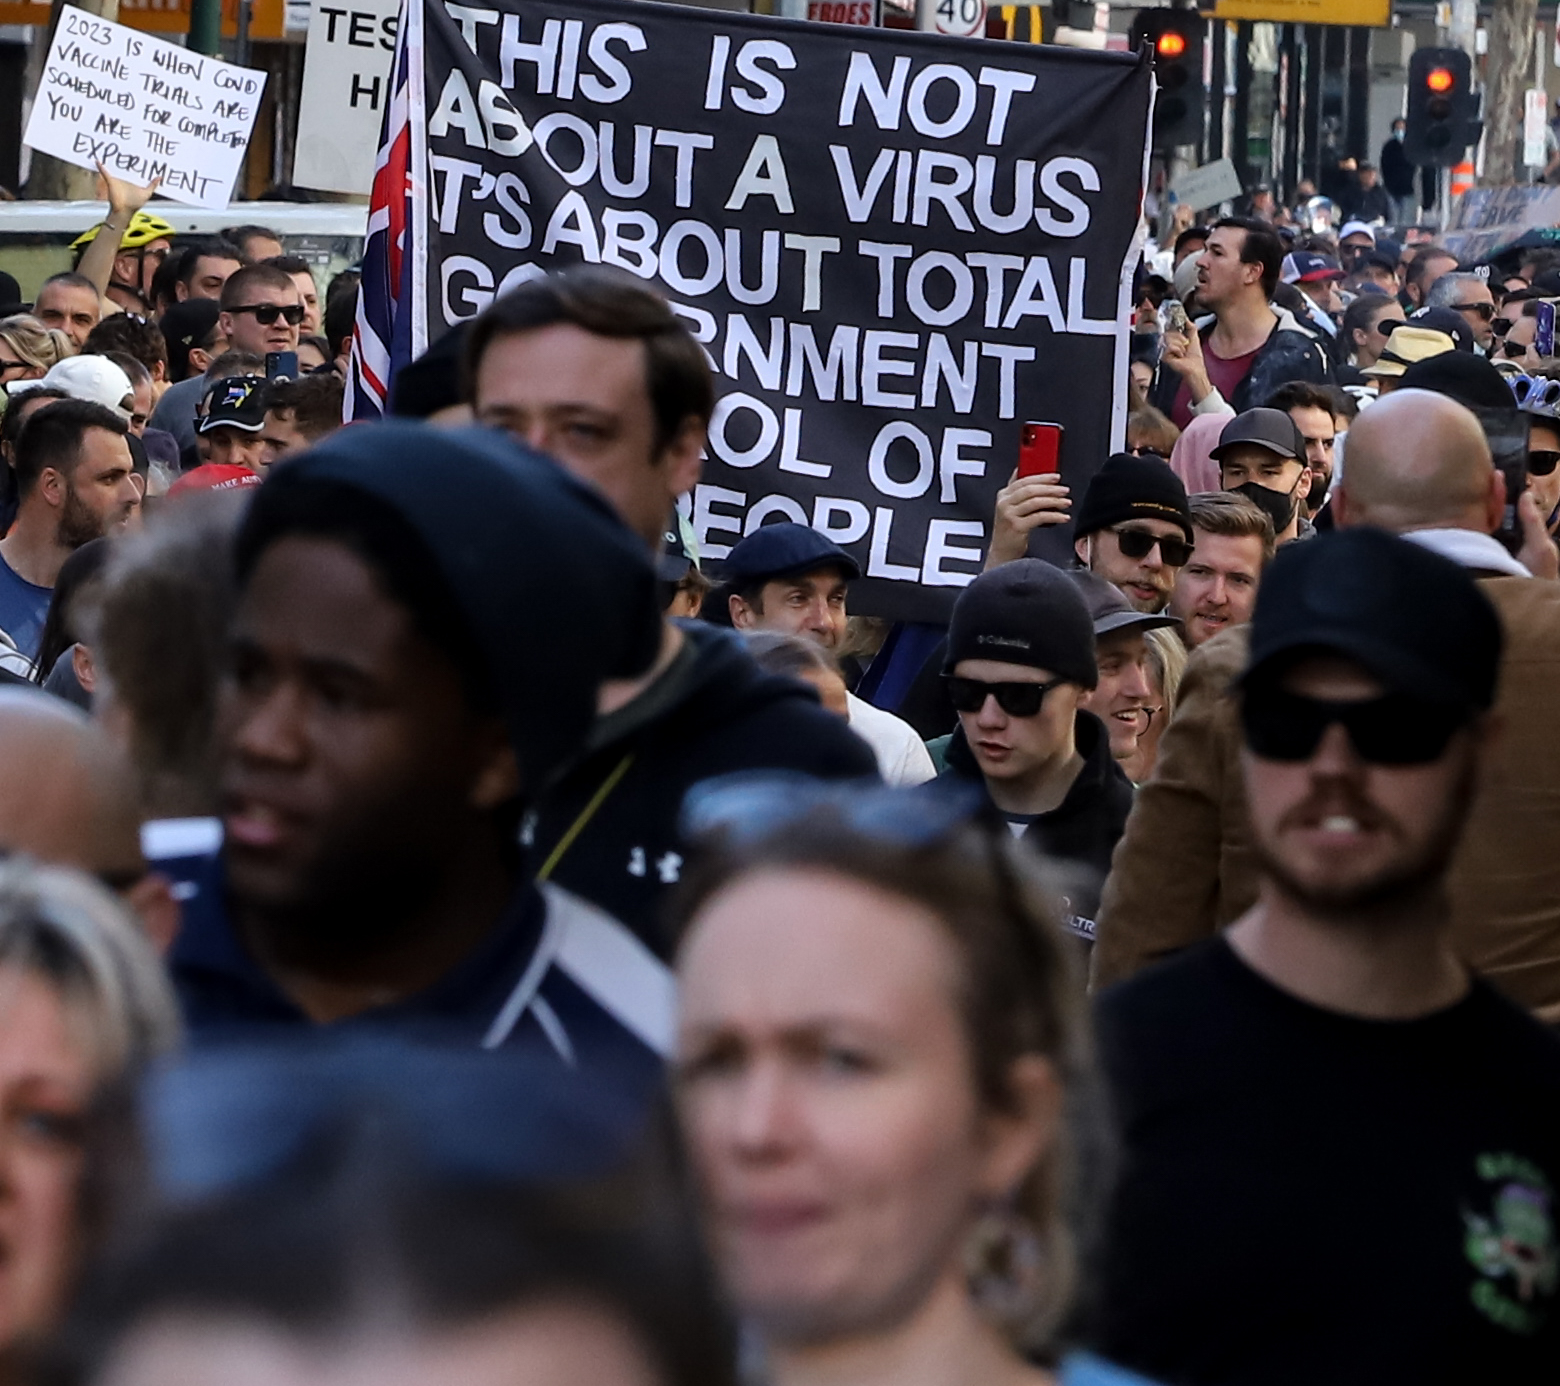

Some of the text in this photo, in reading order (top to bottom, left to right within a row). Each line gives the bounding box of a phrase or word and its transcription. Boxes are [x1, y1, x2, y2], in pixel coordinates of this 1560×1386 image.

[58, 41, 249, 121] VACCINE TRIALS ARE
[67, 15, 112, 45] 2023
[127, 38, 144, 56] IS
[153, 49, 204, 81] WHEN
[445, 1, 1037, 146] THIS IS NOT
[47, 91, 181, 156] YOU ARE THE
[48, 67, 135, 110] SCHEDULED
[143, 103, 172, 127] FOR
[73, 132, 224, 200] EXPERIMENT
[429, 68, 715, 209] ABOUT
[724, 134, 794, 215] A
[829, 144, 1102, 240] VIRUS
[541, 188, 843, 313] ABOUT
[856, 242, 1117, 336] TOTAL
[867, 421, 993, 505] OF
[682, 488, 986, 589] EOPLE
